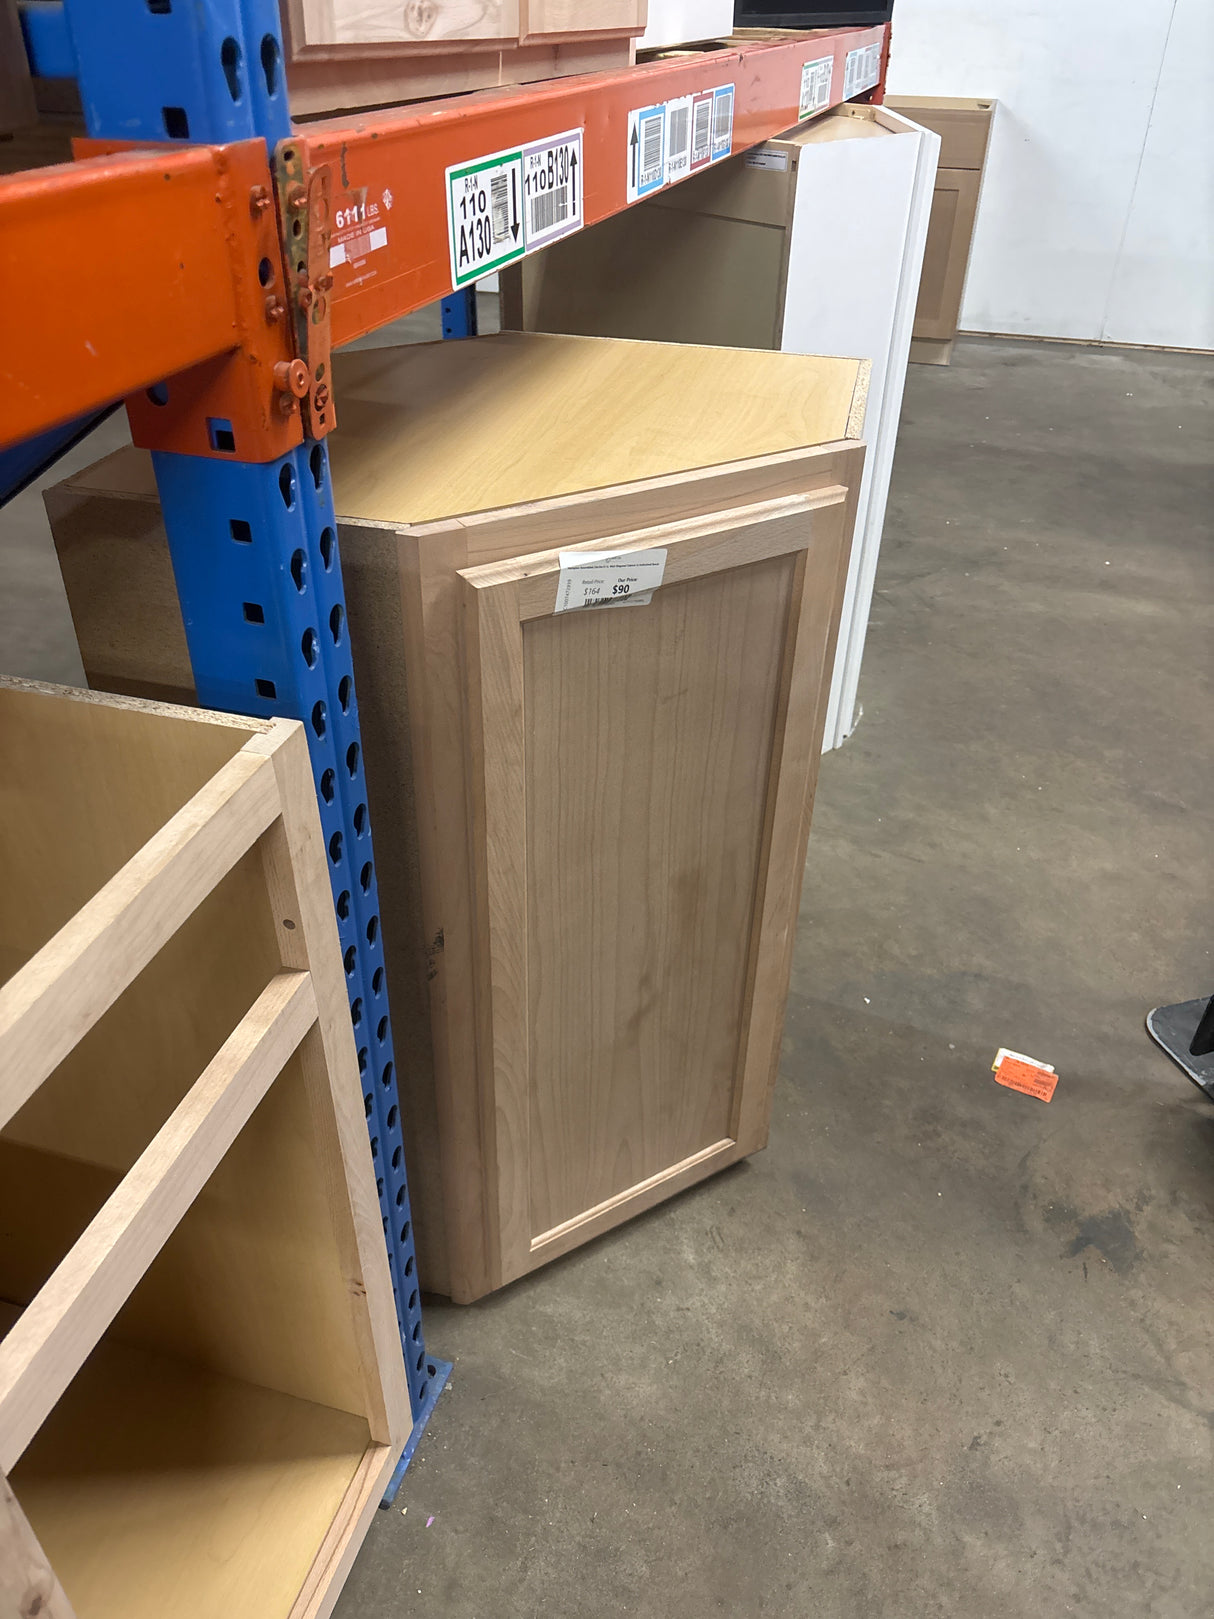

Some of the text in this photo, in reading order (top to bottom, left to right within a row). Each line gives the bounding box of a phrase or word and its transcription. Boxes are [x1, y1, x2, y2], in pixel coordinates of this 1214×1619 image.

[464, 174, 478, 193] R-1-N
[335, 203, 366, 228] 6111
[460, 190, 487, 220] 110
[459, 215, 492, 268] A130
[583, 587, 601, 596] $164
[612, 584, 630, 595] $90
